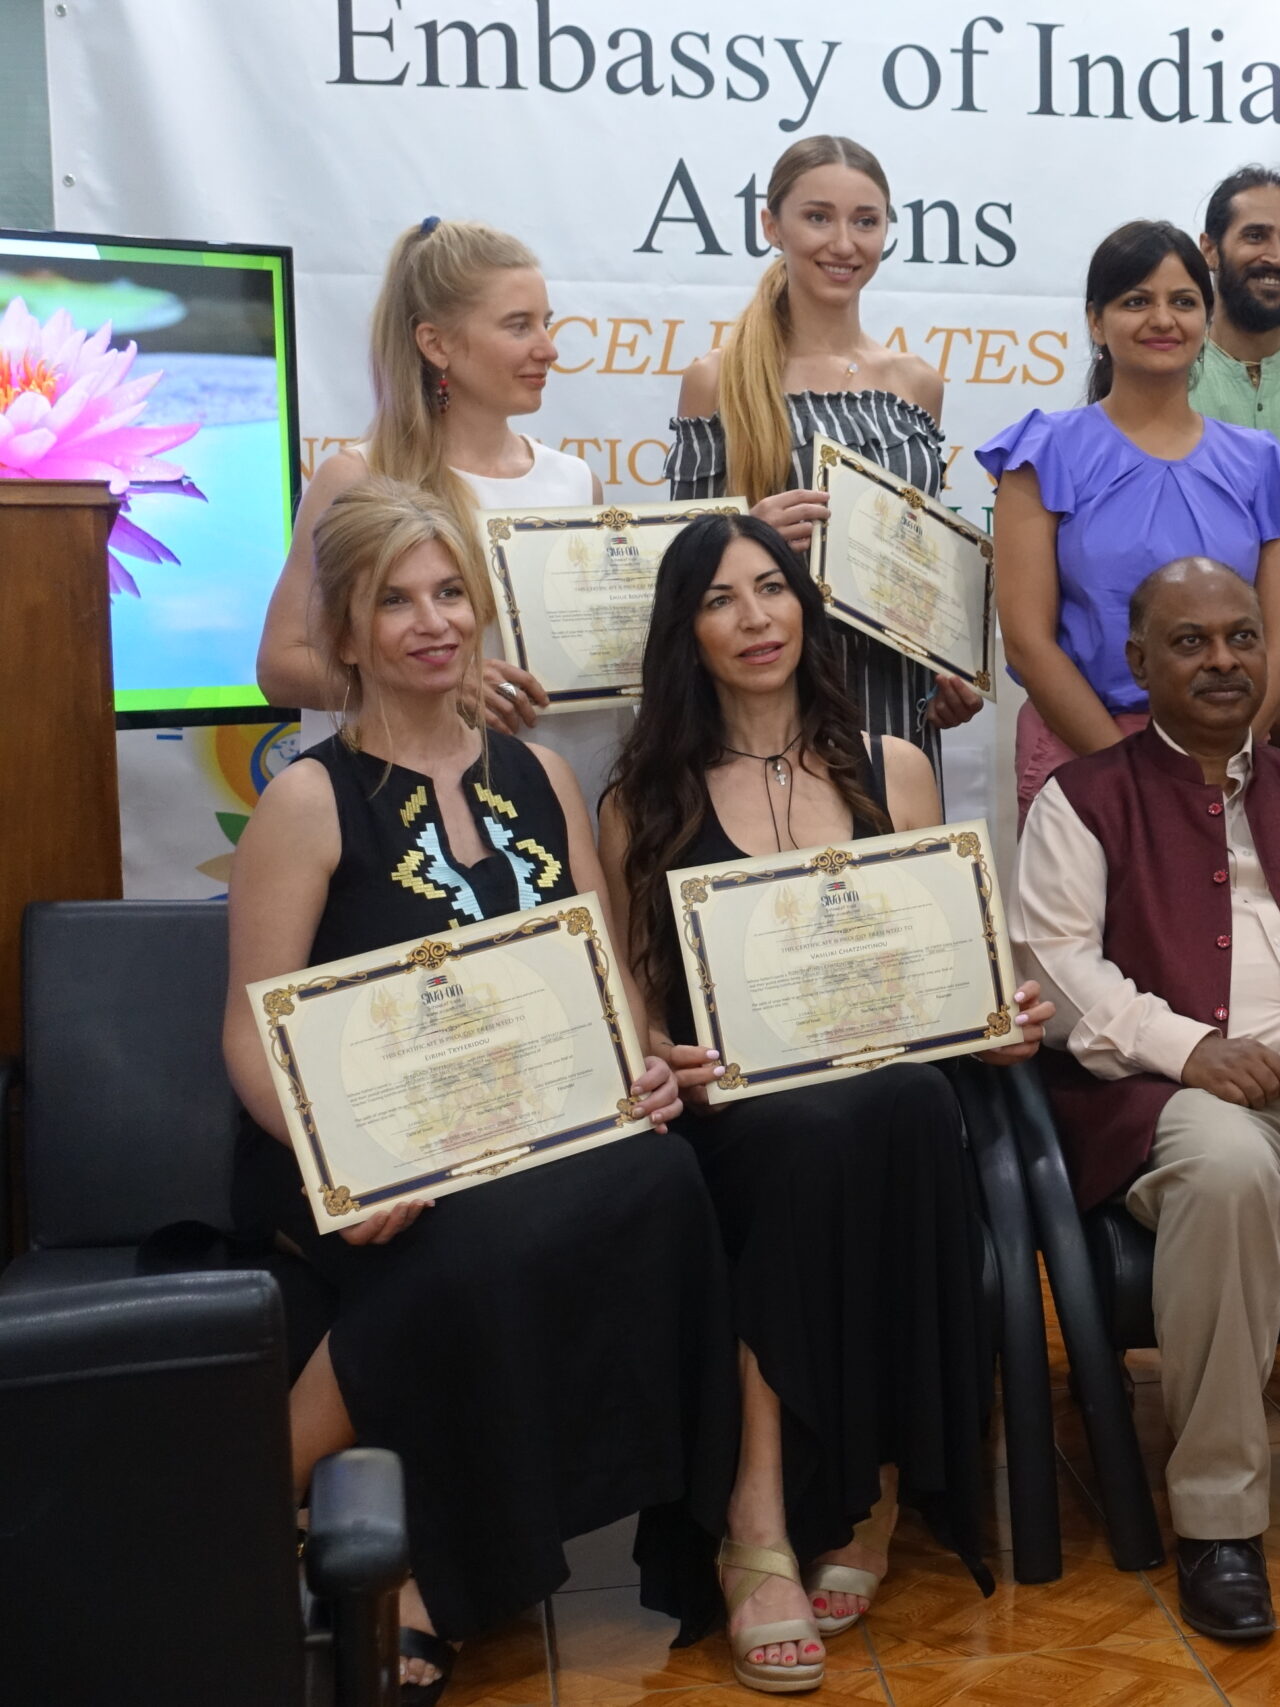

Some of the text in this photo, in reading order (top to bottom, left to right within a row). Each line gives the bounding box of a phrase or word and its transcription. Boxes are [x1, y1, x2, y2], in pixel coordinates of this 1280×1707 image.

[325, 0, 843, 132] Embassy
[882, 16, 1004, 112] of
[632, 157, 1017, 267] Atns
